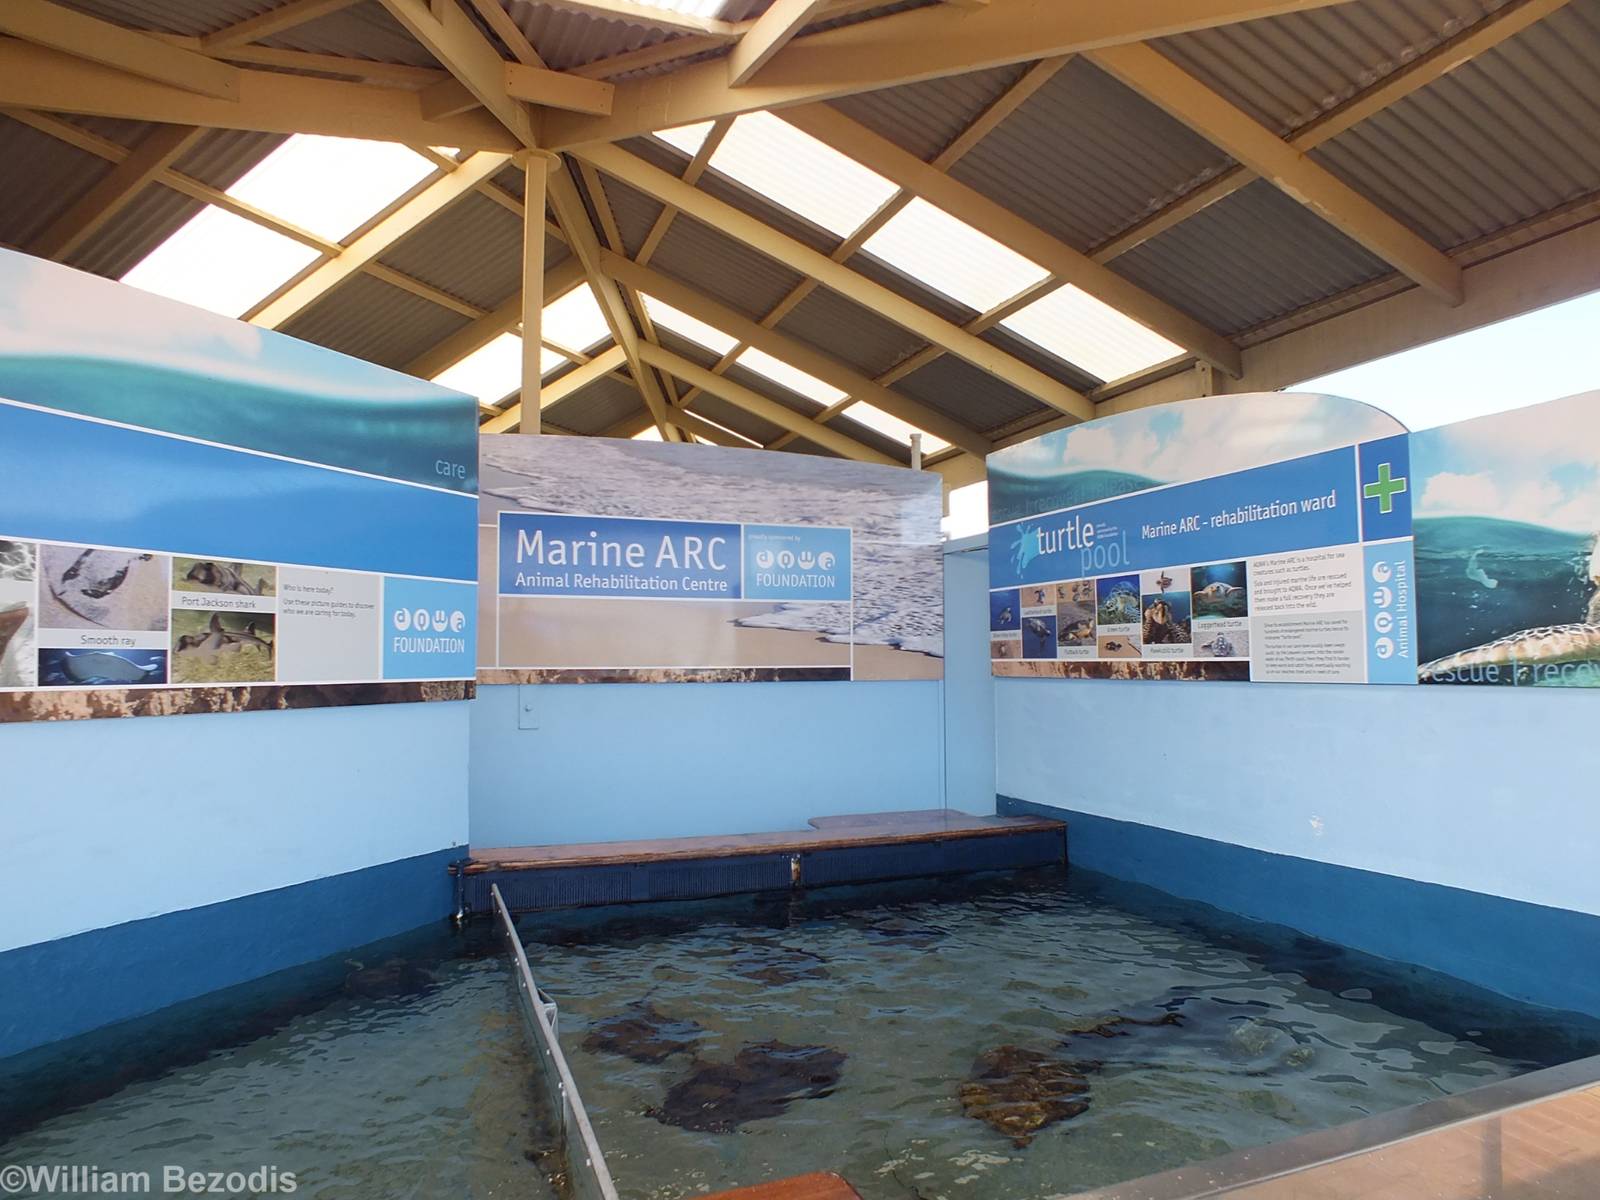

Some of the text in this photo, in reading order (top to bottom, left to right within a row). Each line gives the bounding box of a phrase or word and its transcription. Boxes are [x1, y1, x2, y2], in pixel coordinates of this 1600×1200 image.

[435, 459, 466, 479] care
[1141, 521, 1177, 539] Marine
[1179, 515, 1201, 533] ARC
[1210, 500, 1297, 528] rehabilitation
[1300, 489, 1336, 513] ward
[1036, 515, 1095, 555] turtle
[516, 529, 727, 570] Marine ARC
[1081, 530, 1130, 578] pool
[515, 572, 728, 592] Animal Rehabilitation Centre
[756, 573, 835, 588] FOUNDATION
[182, 596, 256, 608] Port Jackson shark
[1394, 560, 1409, 658] Animal Hospital
[81, 635, 136, 647] Smooth ray
[393, 637, 465, 653] FOUNDATION
